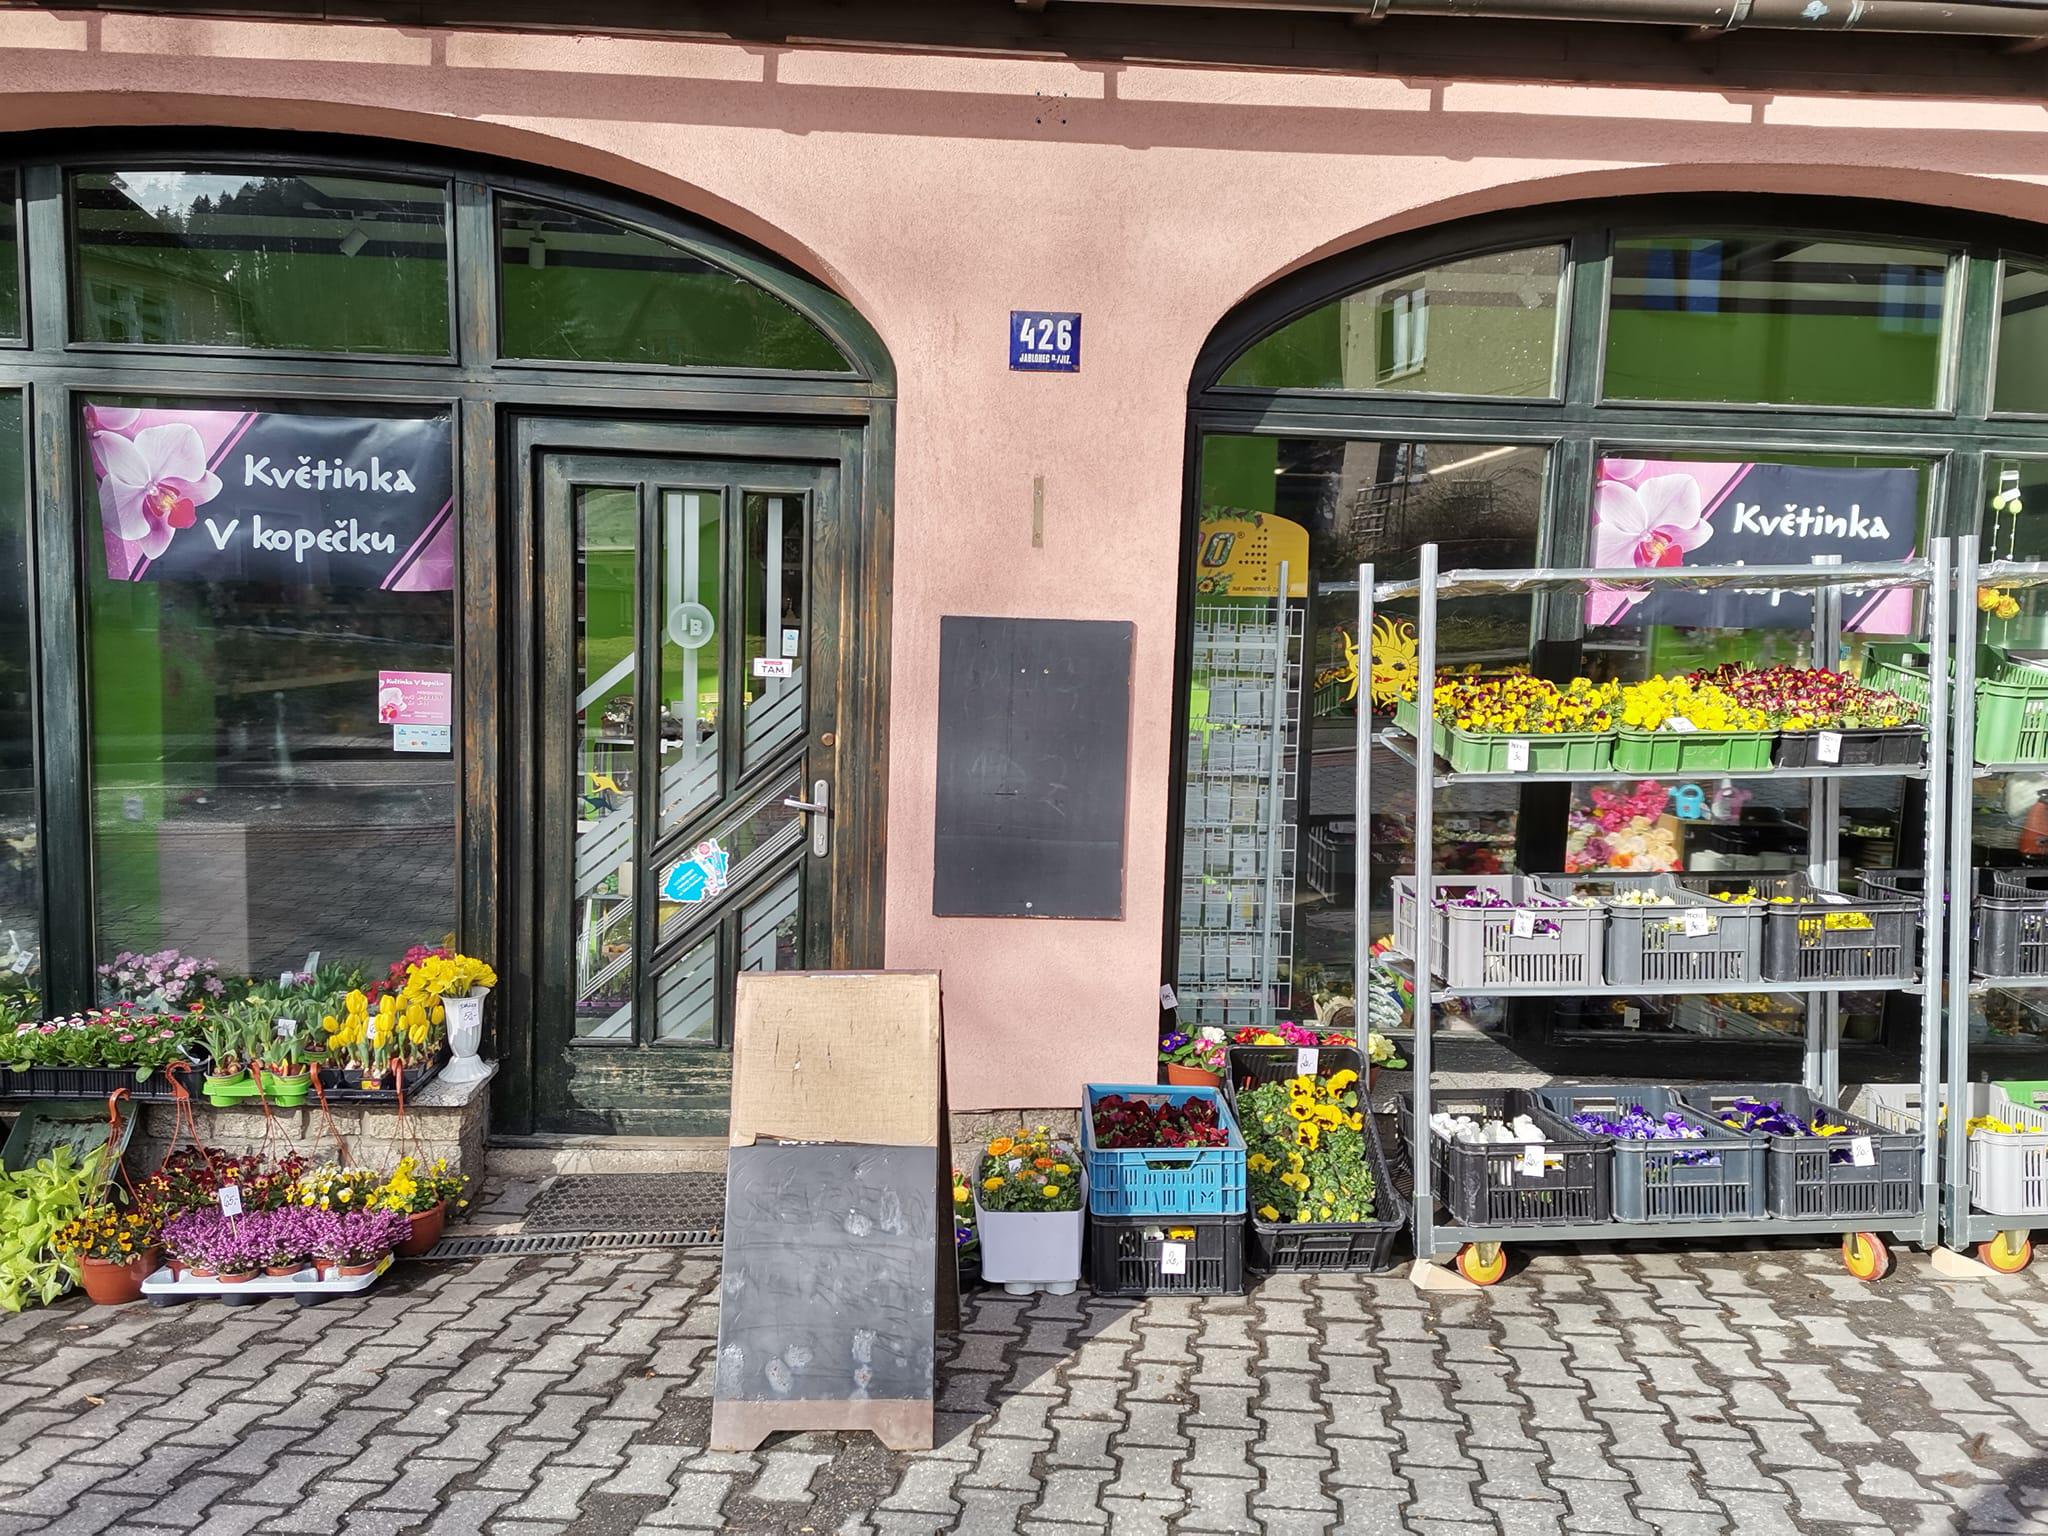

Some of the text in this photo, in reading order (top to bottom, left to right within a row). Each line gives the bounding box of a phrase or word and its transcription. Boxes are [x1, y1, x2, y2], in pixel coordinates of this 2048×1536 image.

[1020, 318, 1072, 351] 426
[1019, 353, 1050, 364] JABLONEC
[244, 454, 416, 493] Květinka
[1733, 502, 1890, 540] Květinka
[204, 514, 396, 564] V kopečku
[761, 665, 785, 674] TAM
